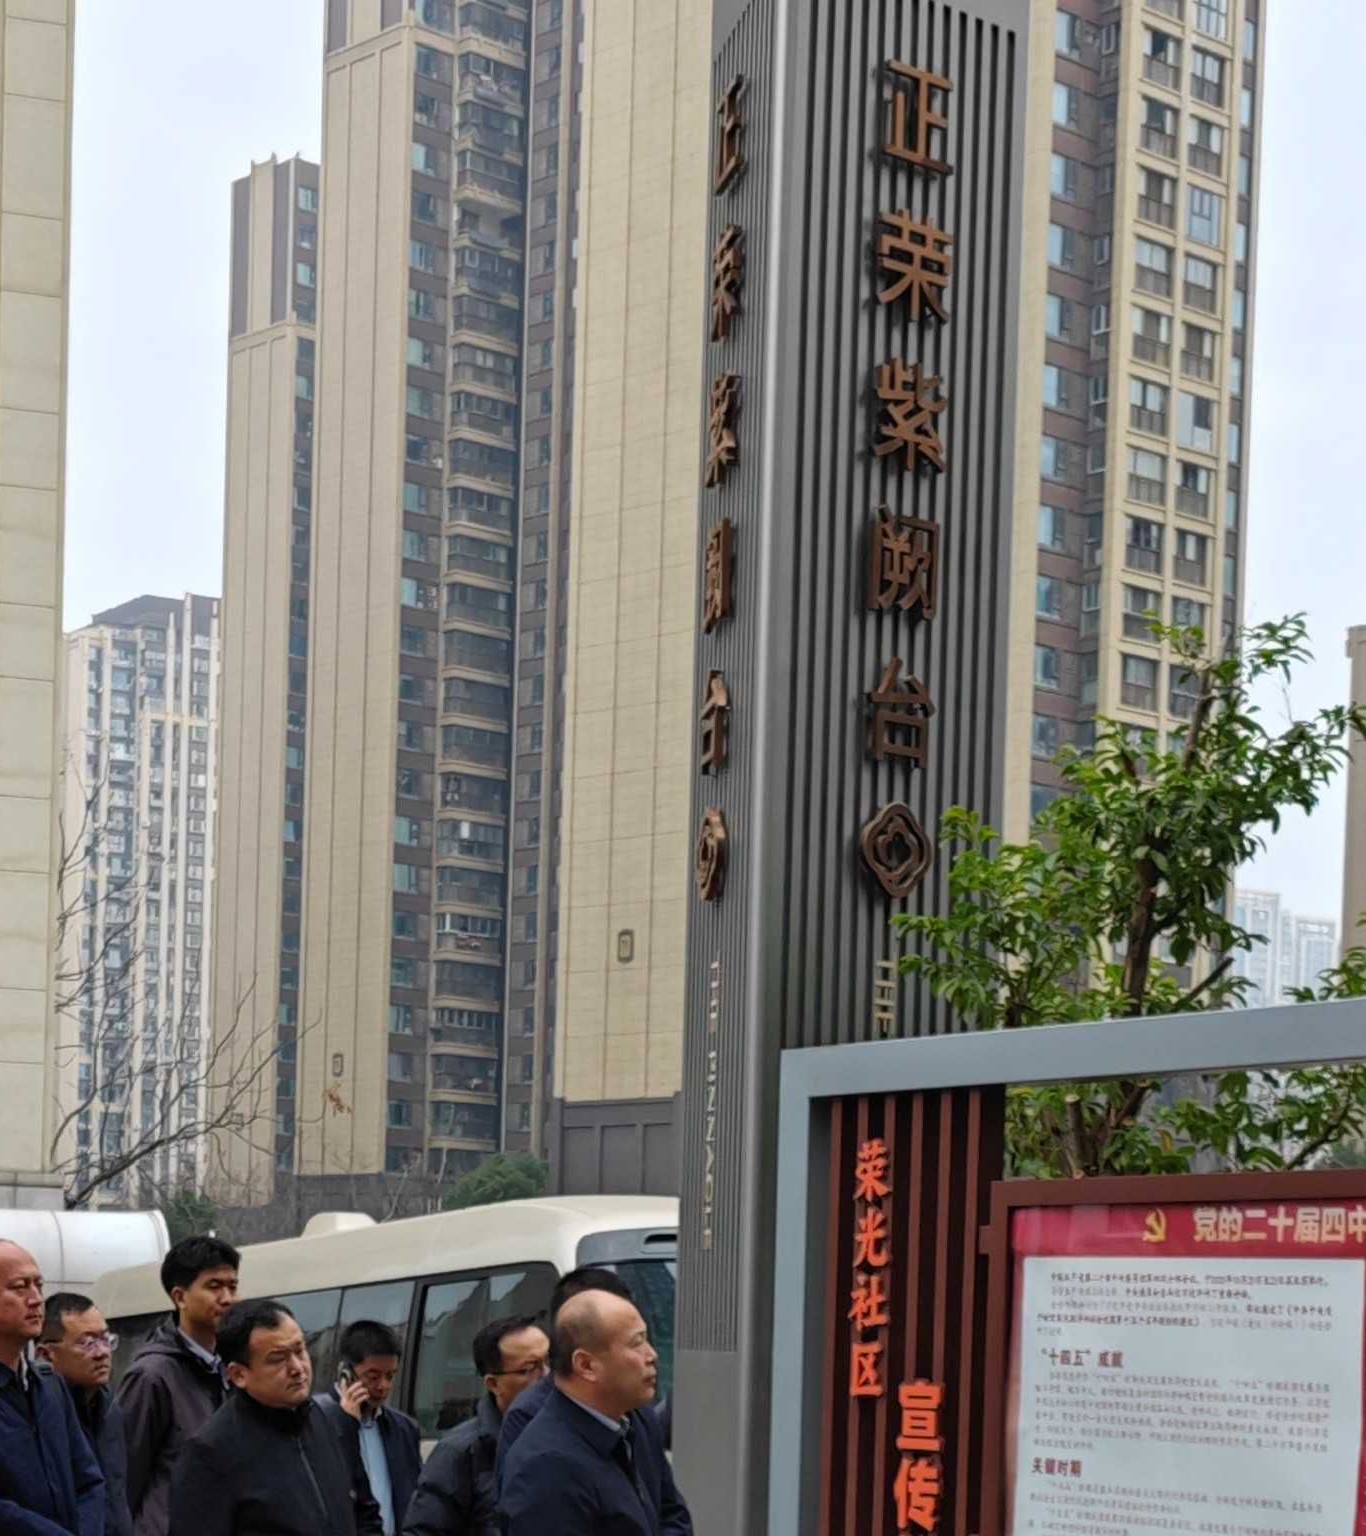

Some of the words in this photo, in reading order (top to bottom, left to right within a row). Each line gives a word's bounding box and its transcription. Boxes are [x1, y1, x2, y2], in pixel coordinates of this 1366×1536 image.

[868, 58, 954, 770] 正荣紫阙台
[849, 1136, 892, 1399] 荣光社区
